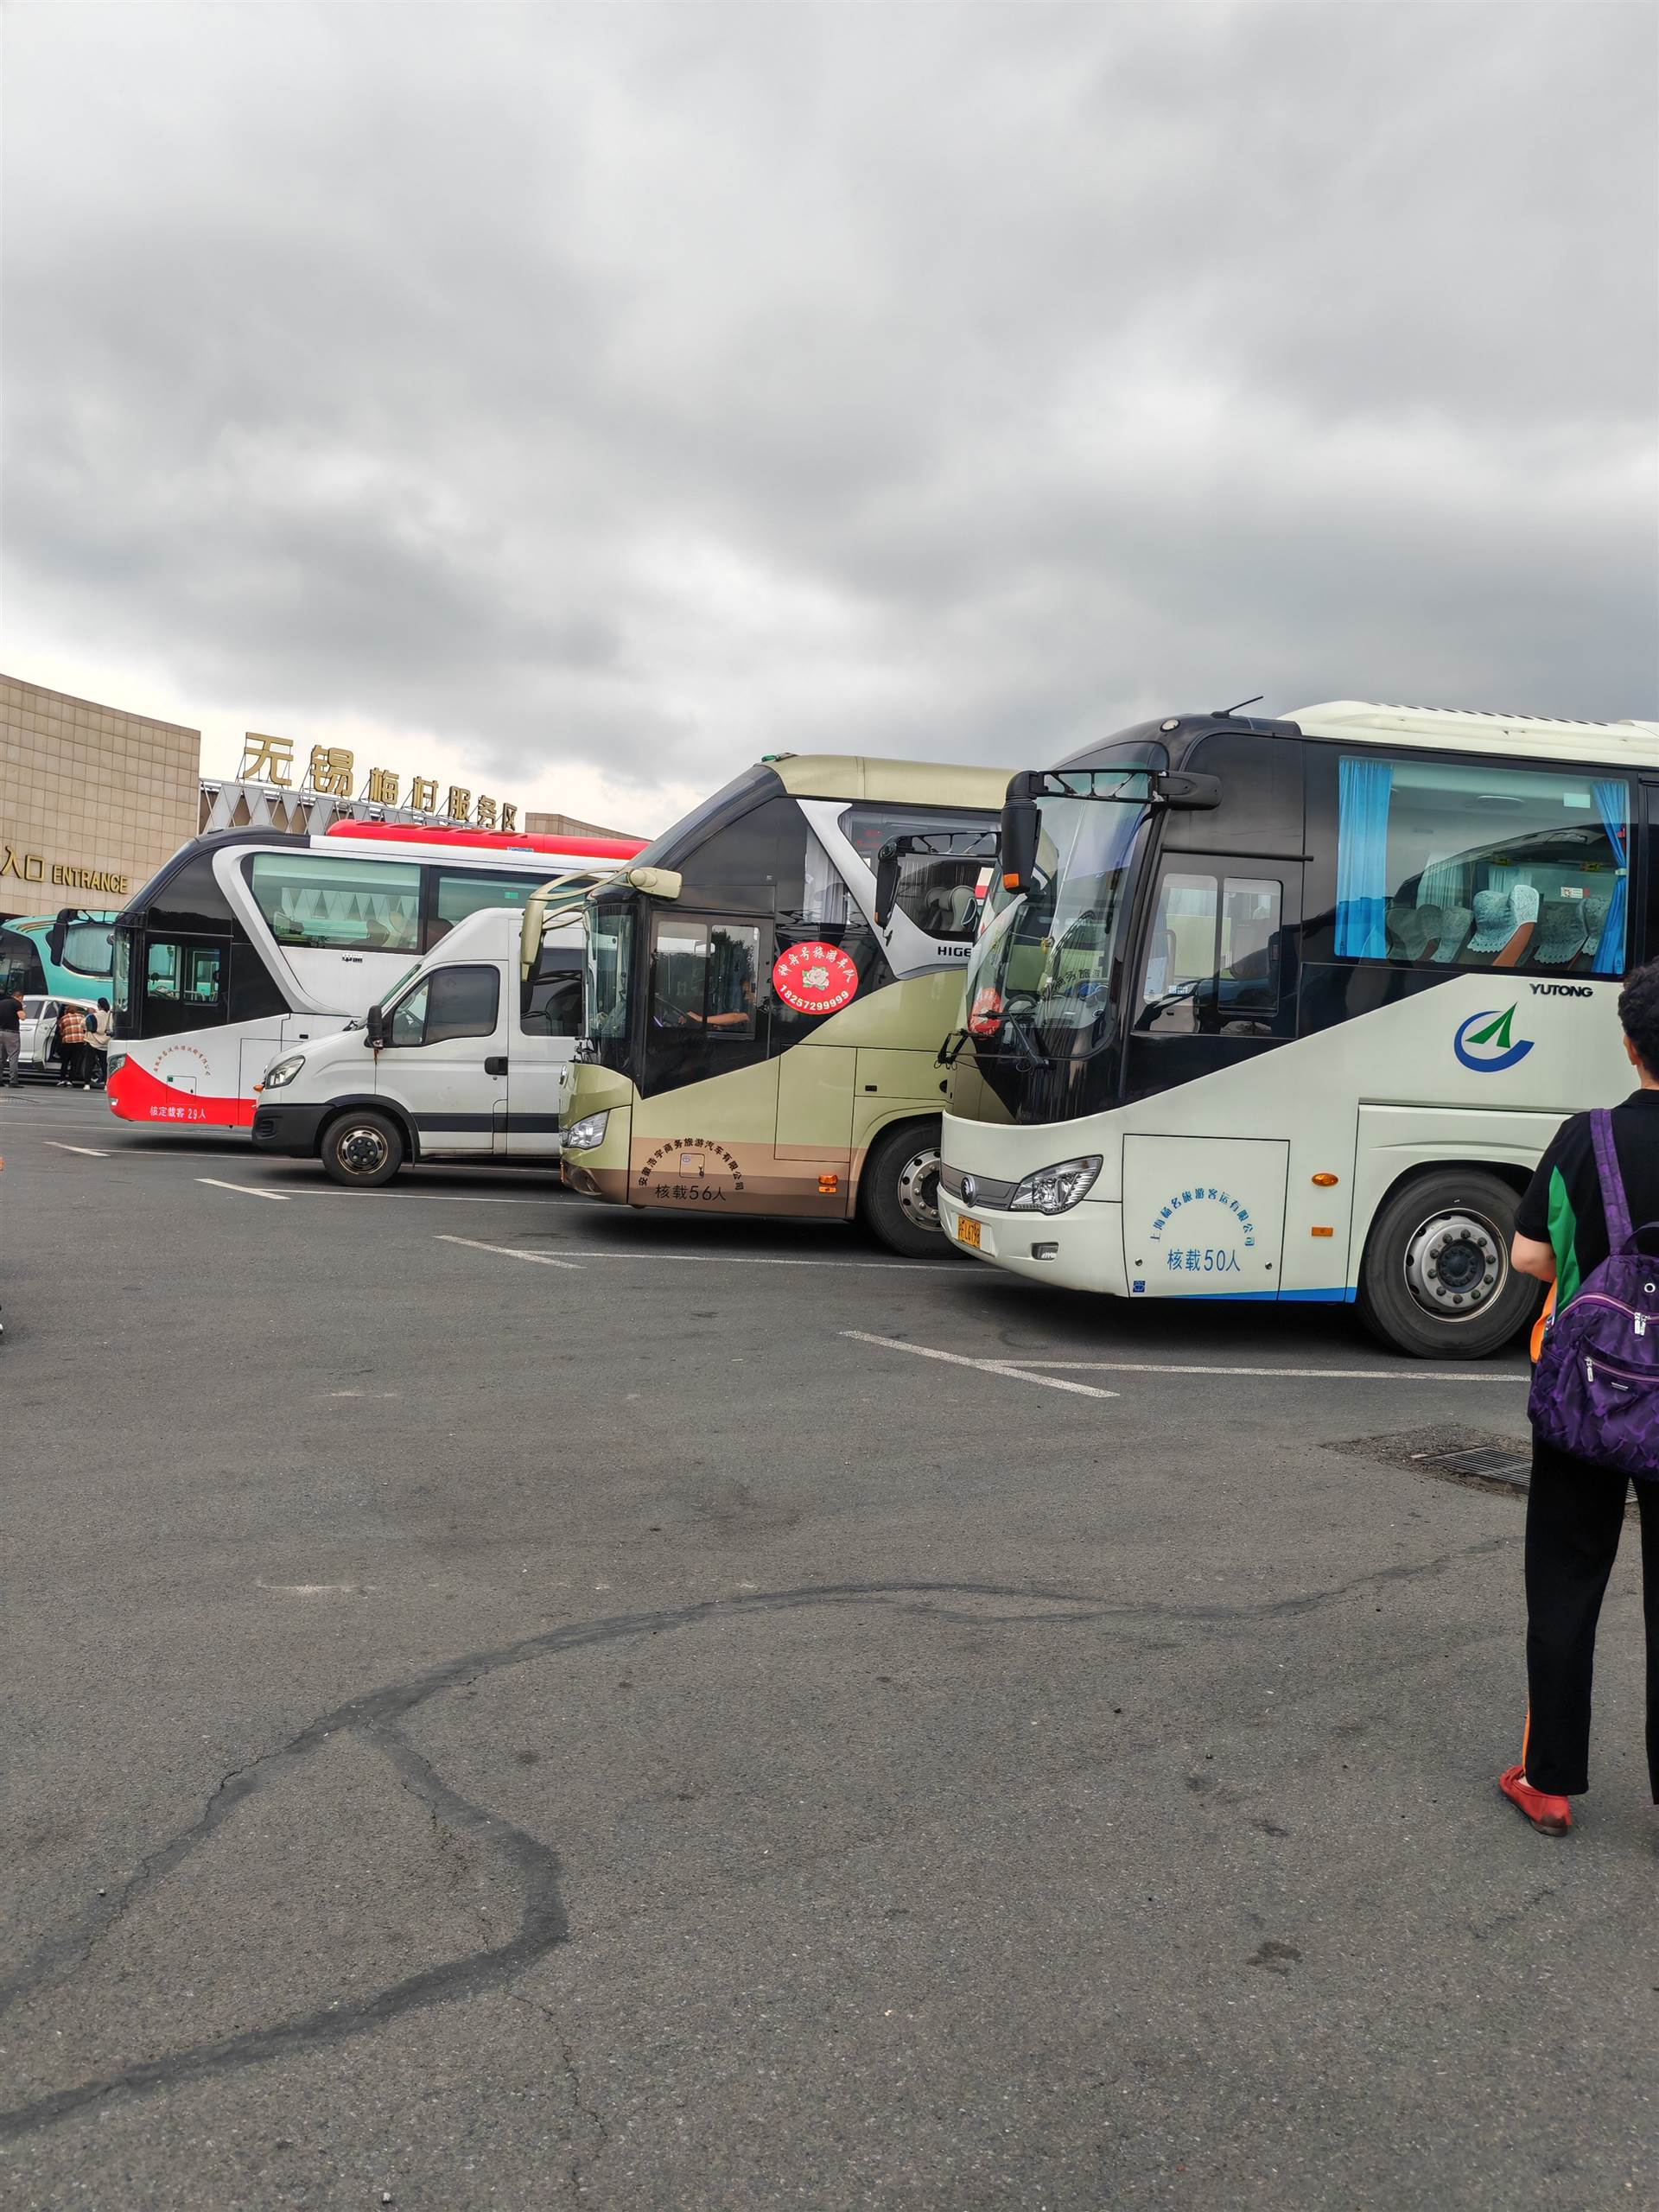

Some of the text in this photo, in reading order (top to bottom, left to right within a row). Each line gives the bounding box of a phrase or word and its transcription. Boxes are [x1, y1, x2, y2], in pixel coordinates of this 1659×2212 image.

[244, 732, 518, 831] 无锡梅村服务区
[0, 846, 130, 894] 入口 ENTRANCE
[938, 946, 972, 957] HIGE
[779, 984, 849, 1011] 18257299999
[1529, 983, 1594, 997] YUTONG
[655, 1184, 726, 1201] 核载56人
[1166, 1249, 1241, 1272] 核载50人
